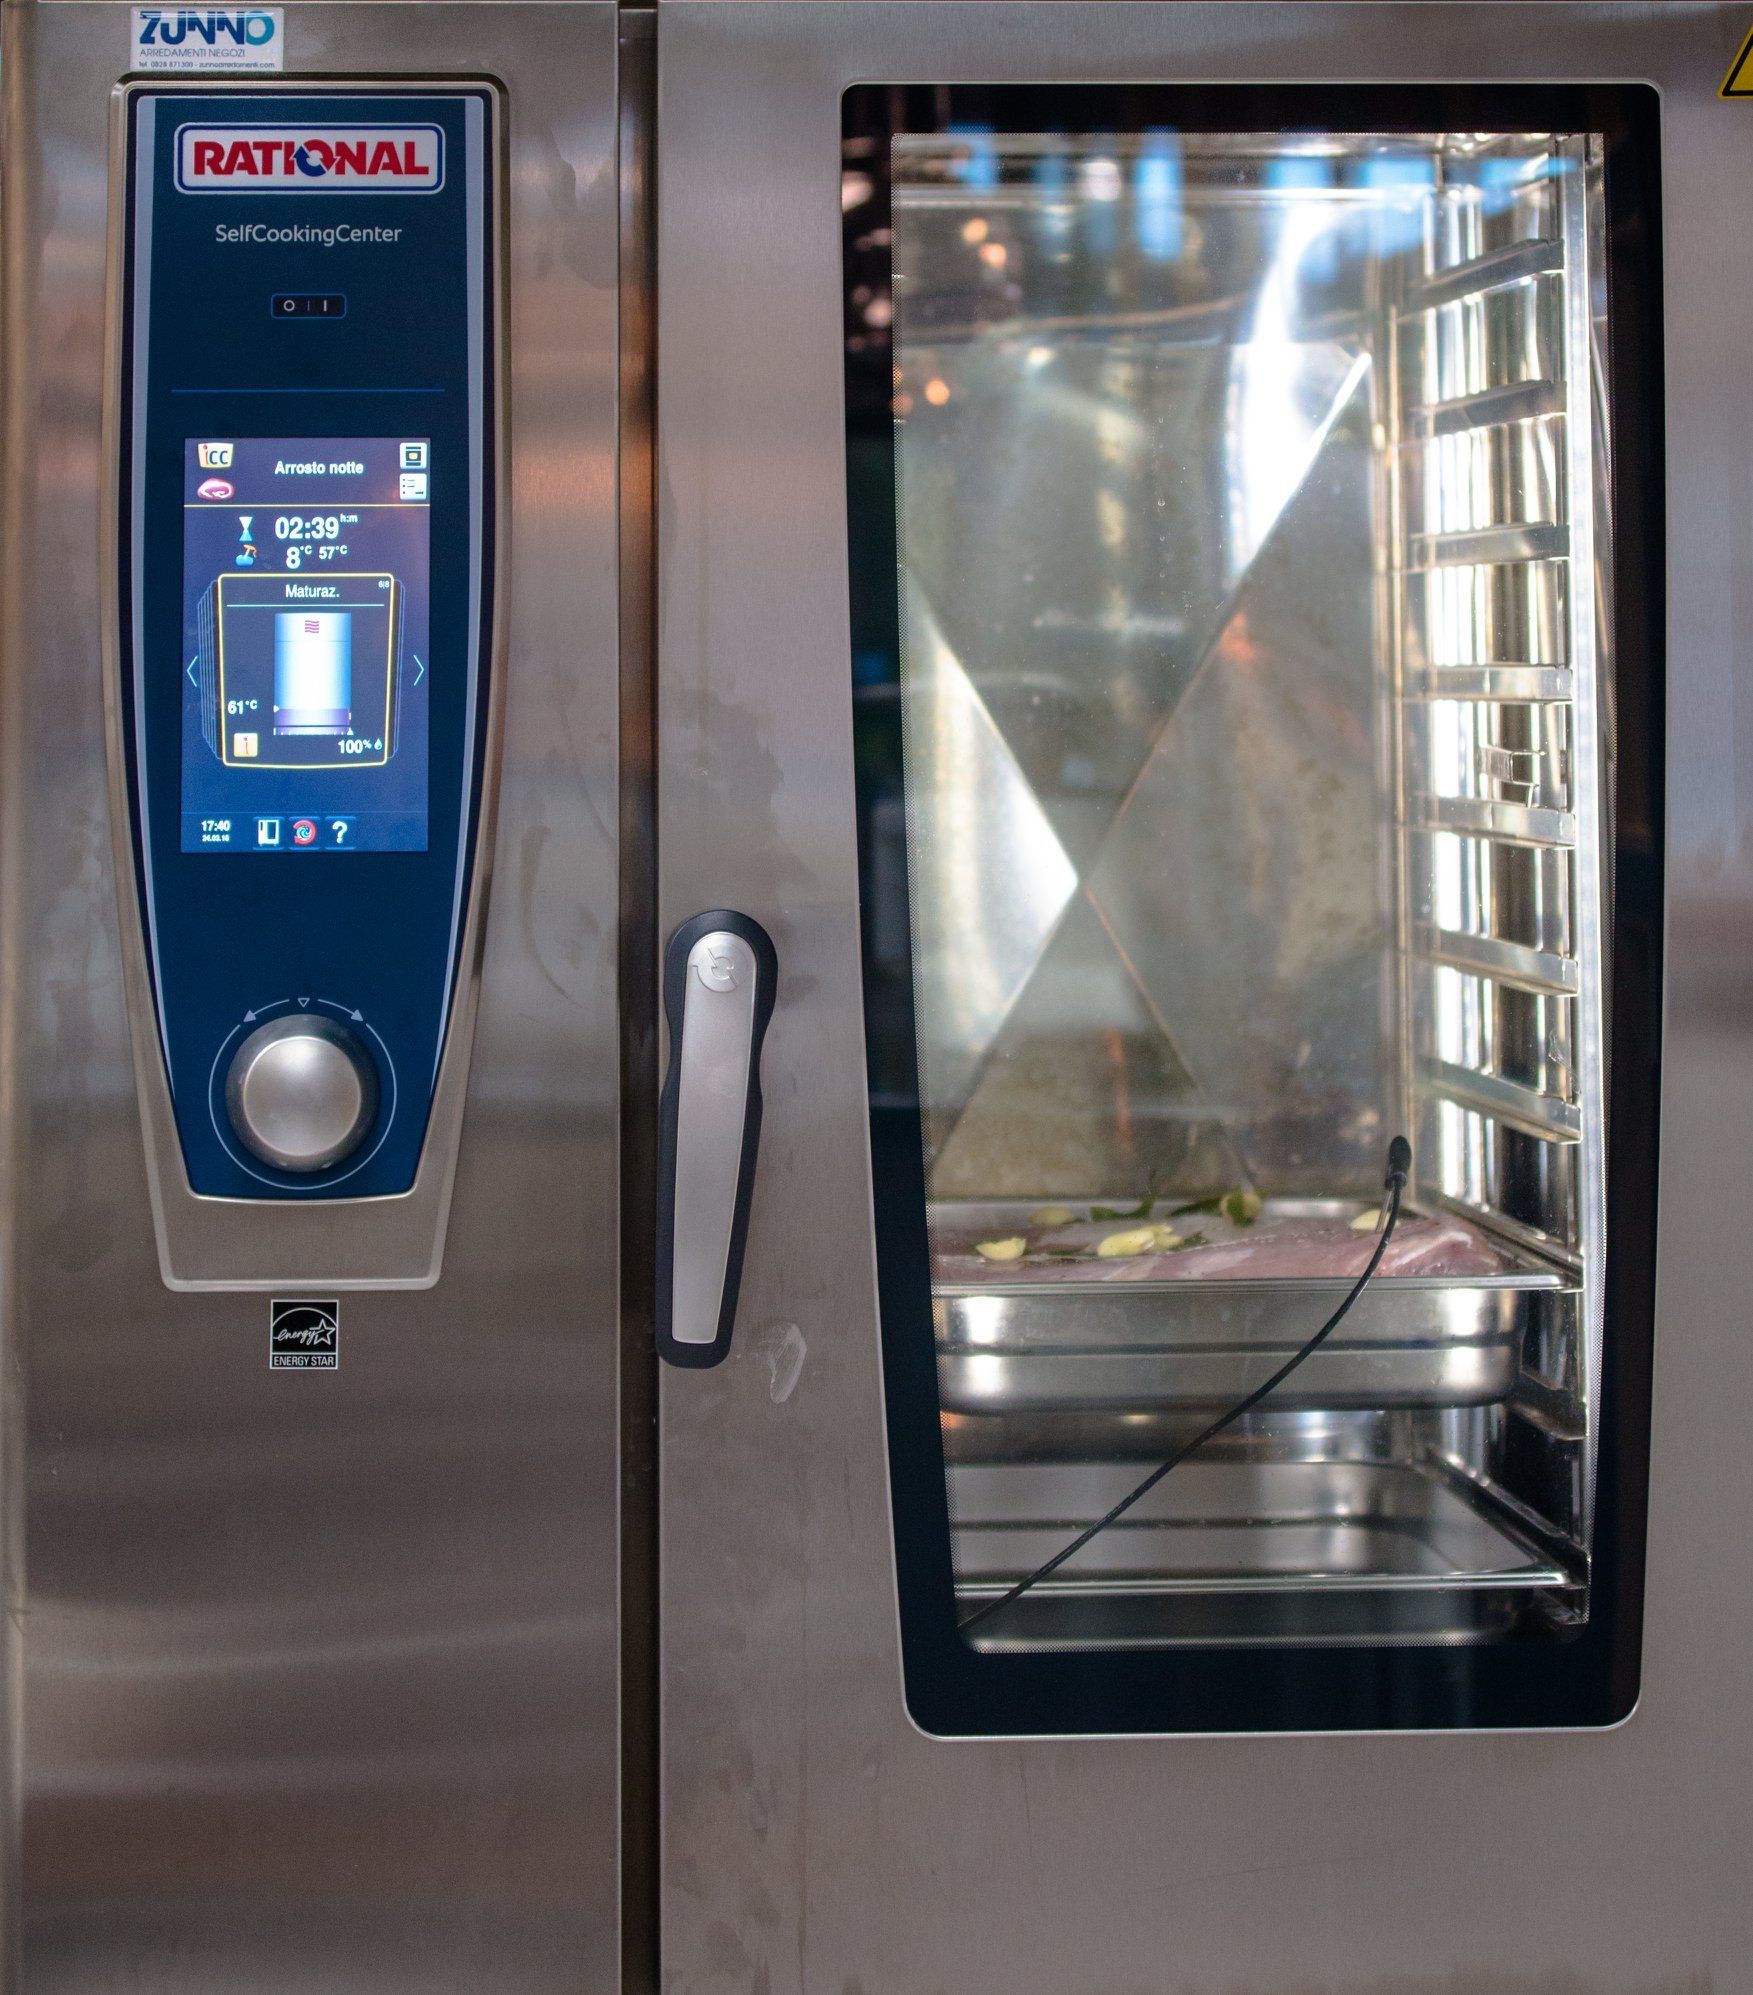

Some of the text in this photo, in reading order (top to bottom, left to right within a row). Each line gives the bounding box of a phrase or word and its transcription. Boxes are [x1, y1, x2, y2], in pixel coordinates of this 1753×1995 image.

[139, 11, 275, 46] ZUNNO
[139, 48, 246, 58] ARREDAMENTI NEGOZI
[193, 139, 430, 177] RATIONAL
[215, 224, 403, 247] SelfCookingCenter
[274, 461, 364, 475] Arrosto notte
[275, 516, 340, 540] 02:39
[285, 584, 340, 599] Maturaz.
[338, 739, 372, 754] 100%
[201, 820, 231, 831] 17:40
[273, 1356, 335, 1366] ENERGY STAR
